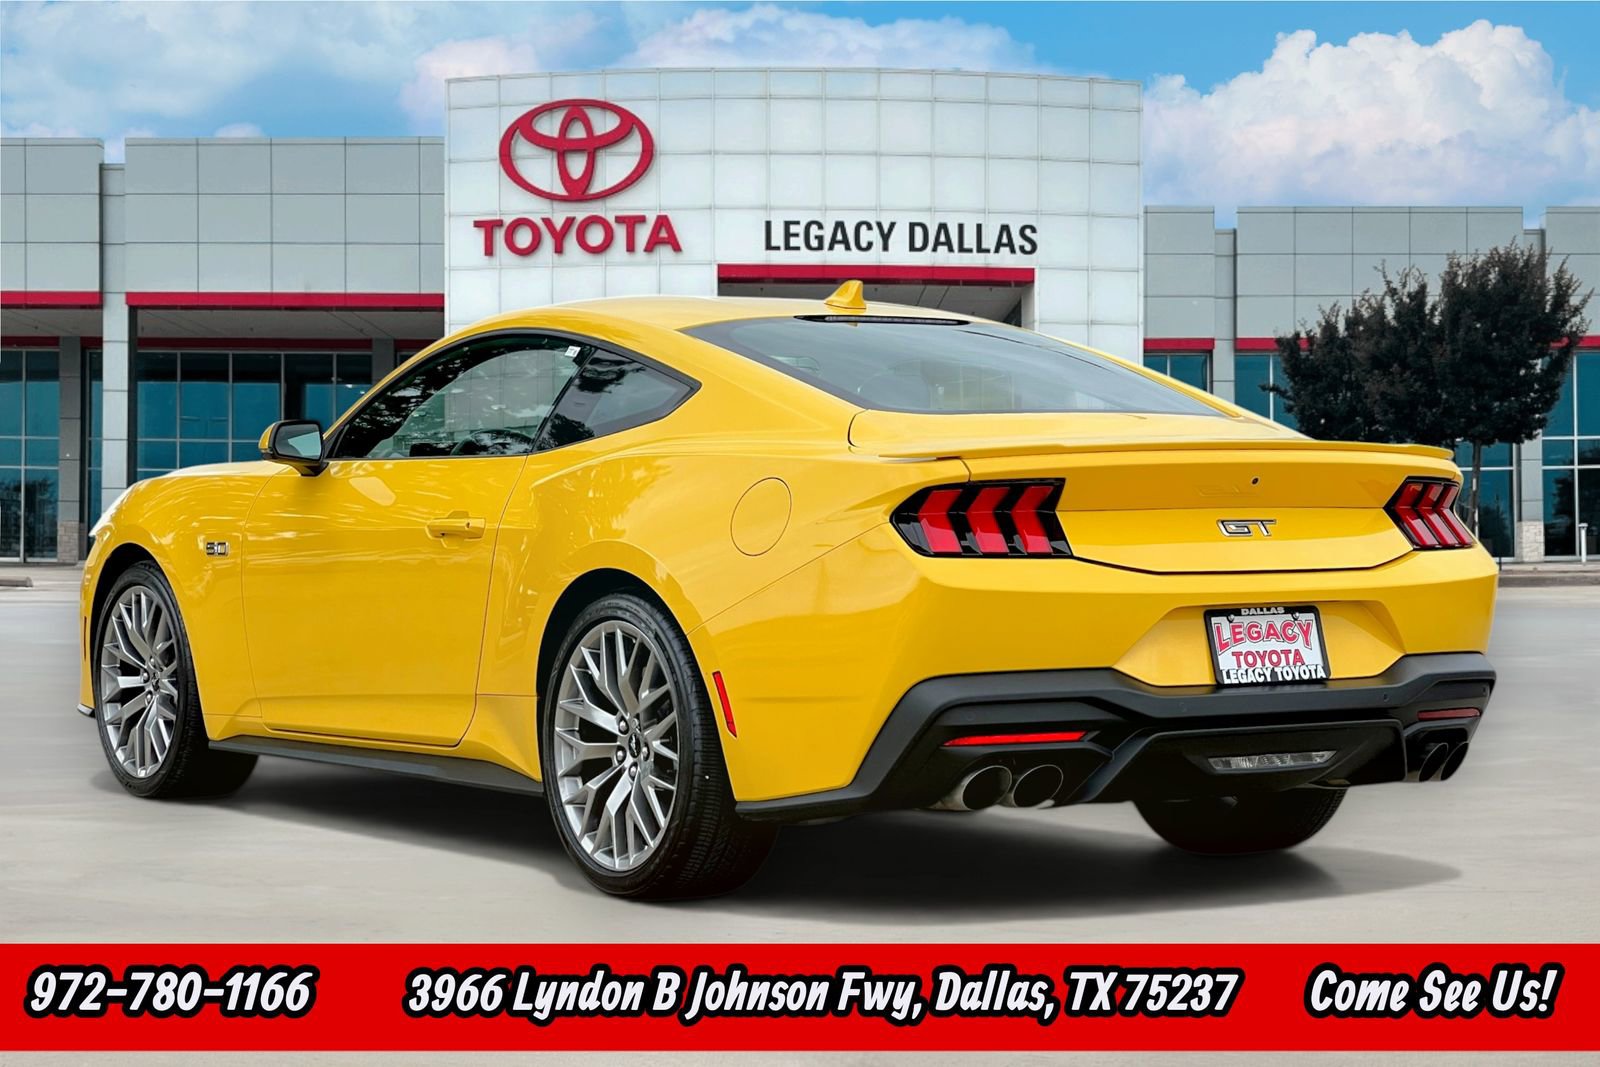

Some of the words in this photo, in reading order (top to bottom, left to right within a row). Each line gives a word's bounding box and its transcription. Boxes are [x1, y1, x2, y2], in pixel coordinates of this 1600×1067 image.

[474, 214, 682, 256] TOYOTA
[765, 220, 897, 252] LEGACY
[908, 221, 1038, 255] DALLAS
[1216, 519, 1277, 537] GT
[1241, 606, 1285, 616] DALLAS
[1214, 619, 1313, 656] LEGACY
[1232, 649, 1306, 669] TOYOTA
[1222, 666, 1273, 684] LEGACY
[1274, 664, 1326, 682] TOYOTA
